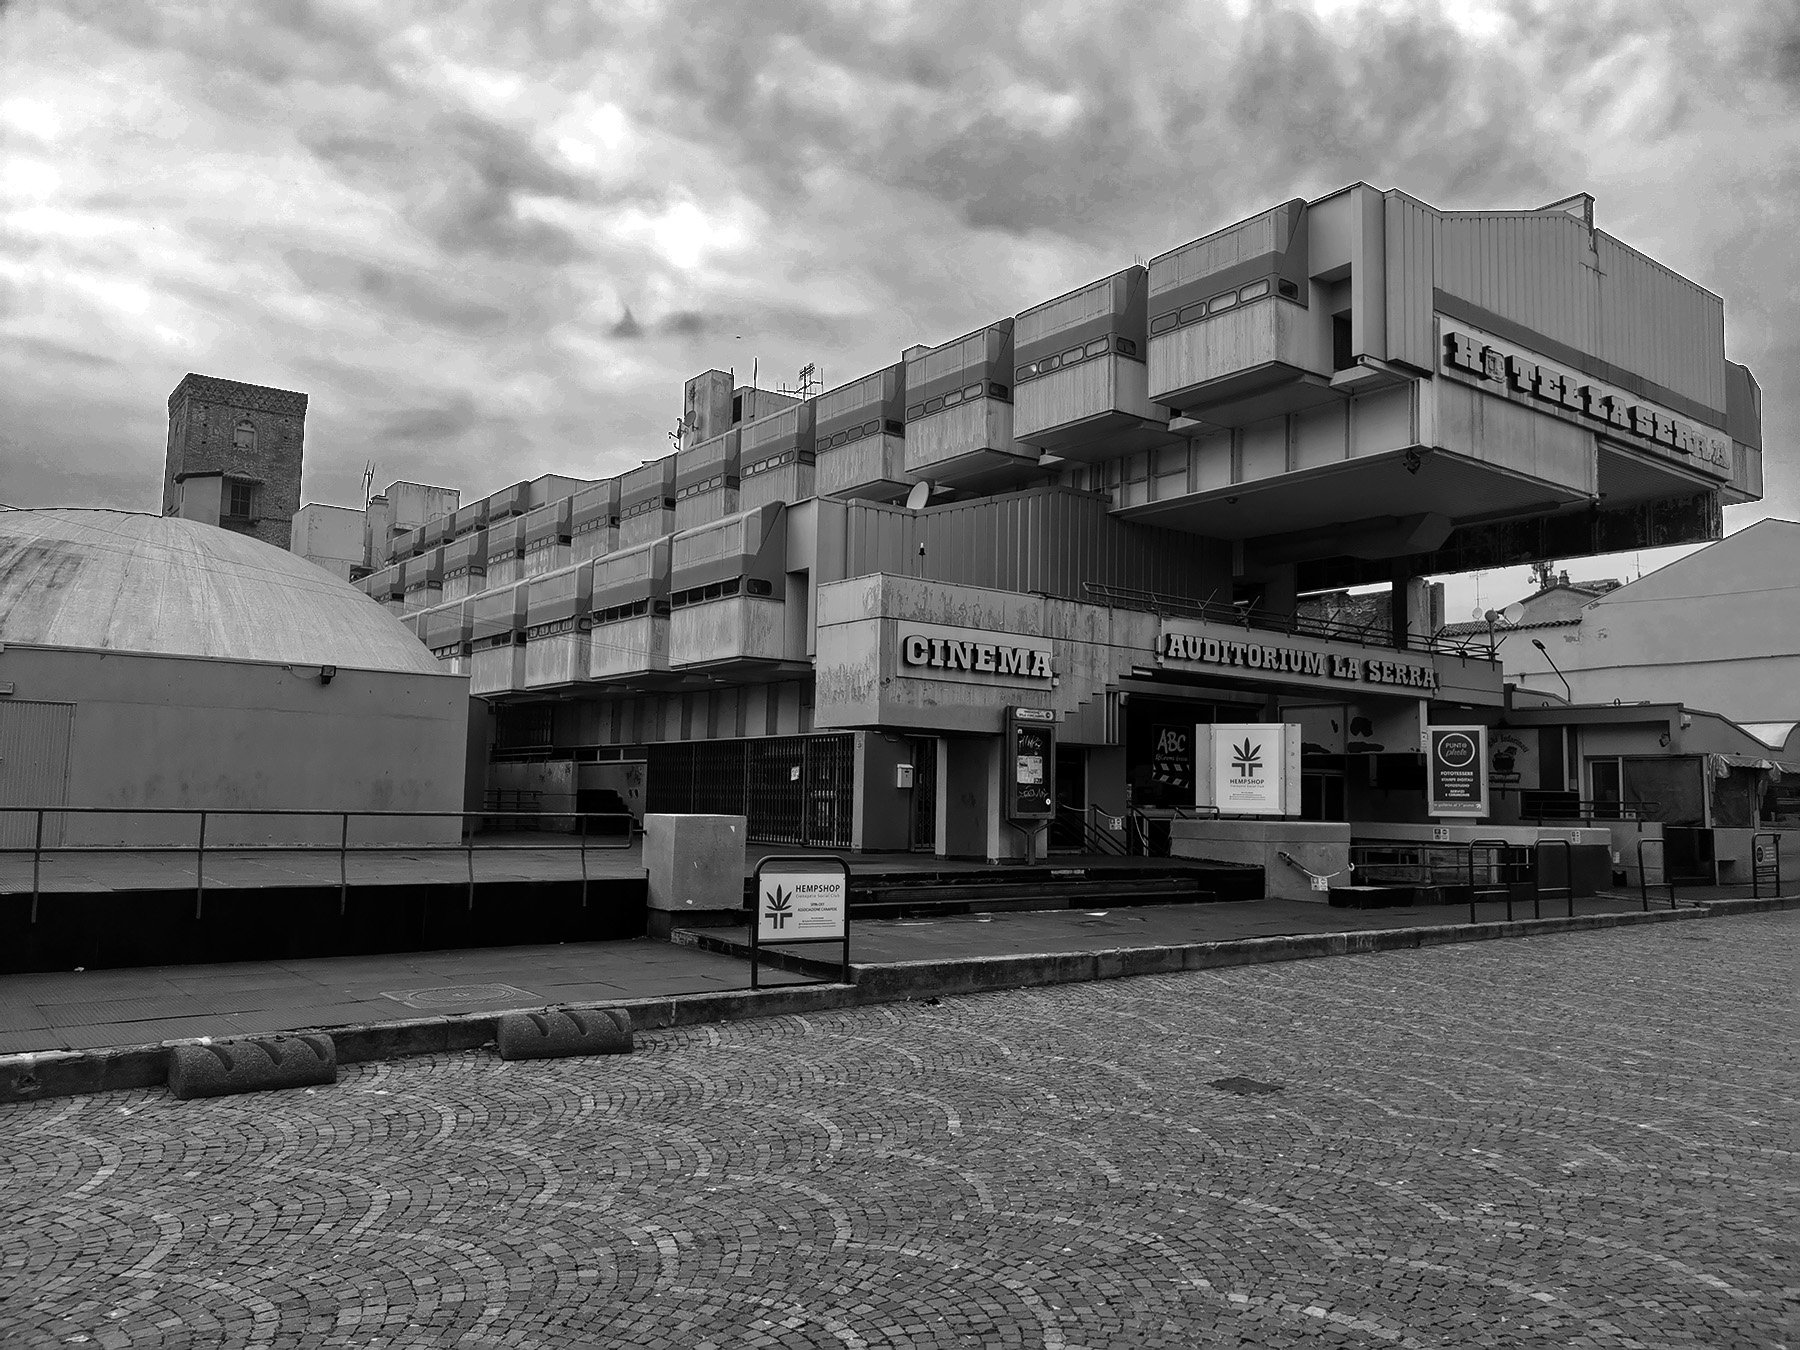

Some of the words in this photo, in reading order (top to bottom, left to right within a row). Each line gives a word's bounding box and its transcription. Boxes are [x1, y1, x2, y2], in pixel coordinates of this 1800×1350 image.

[1585, 385, 1631, 429] LA
[1634, 405, 1731, 469] SERRA
[904, 634, 1053, 678] CINEMA
[1167, 633, 1326, 675] AUDITORIUM
[1333, 654, 1361, 679] LA
[1368, 660, 1437, 688] SERRA
[1157, 728, 1186, 754] ABC
[795, 884, 841, 893] HEMPSHOP
